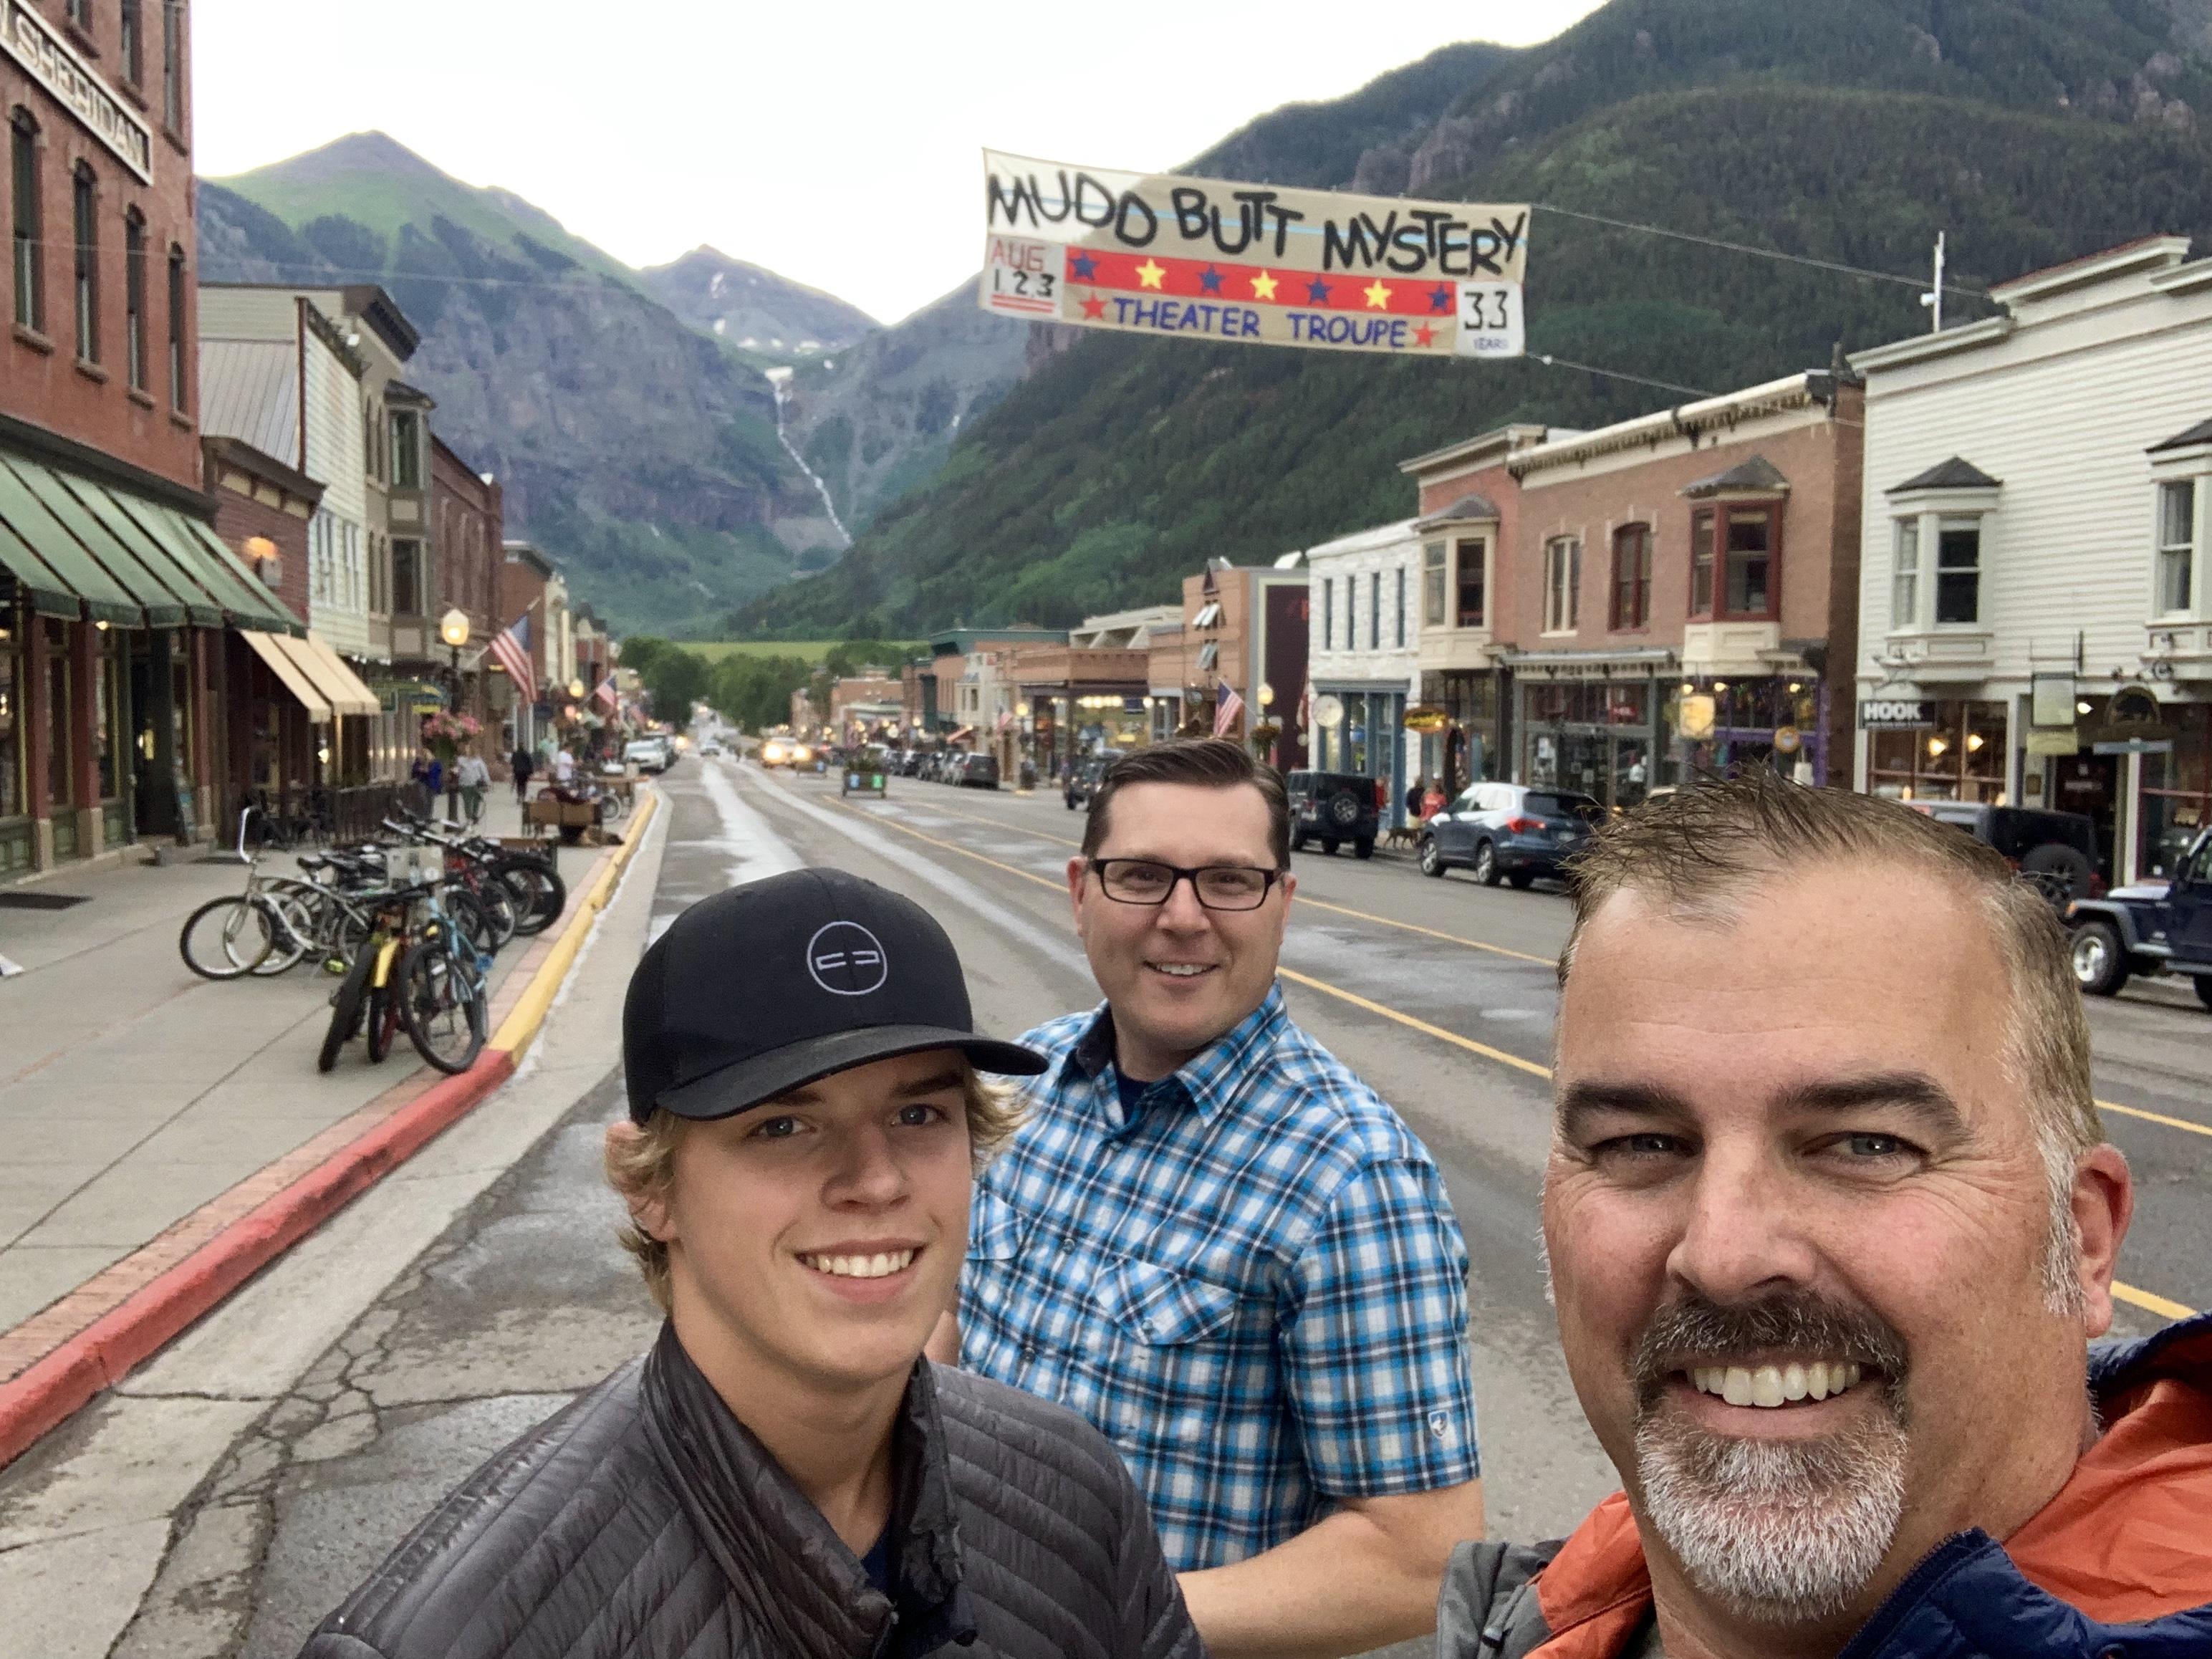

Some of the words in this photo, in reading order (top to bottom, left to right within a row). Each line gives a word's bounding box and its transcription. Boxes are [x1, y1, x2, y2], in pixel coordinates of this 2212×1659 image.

[14, 12, 143, 166] SHERIDAN
[989, 170, 1158, 247] MUDD
[1171, 186, 1304, 257] BUTT
[1323, 210, 1526, 276] MYSTERY
[991, 239, 1045, 271] AUG
[1113, 297, 1260, 337] THEATER
[1286, 313, 1408, 348] TROUPE
[1464, 290, 1508, 330] 33
[1864, 702, 1921, 720] HOOK
